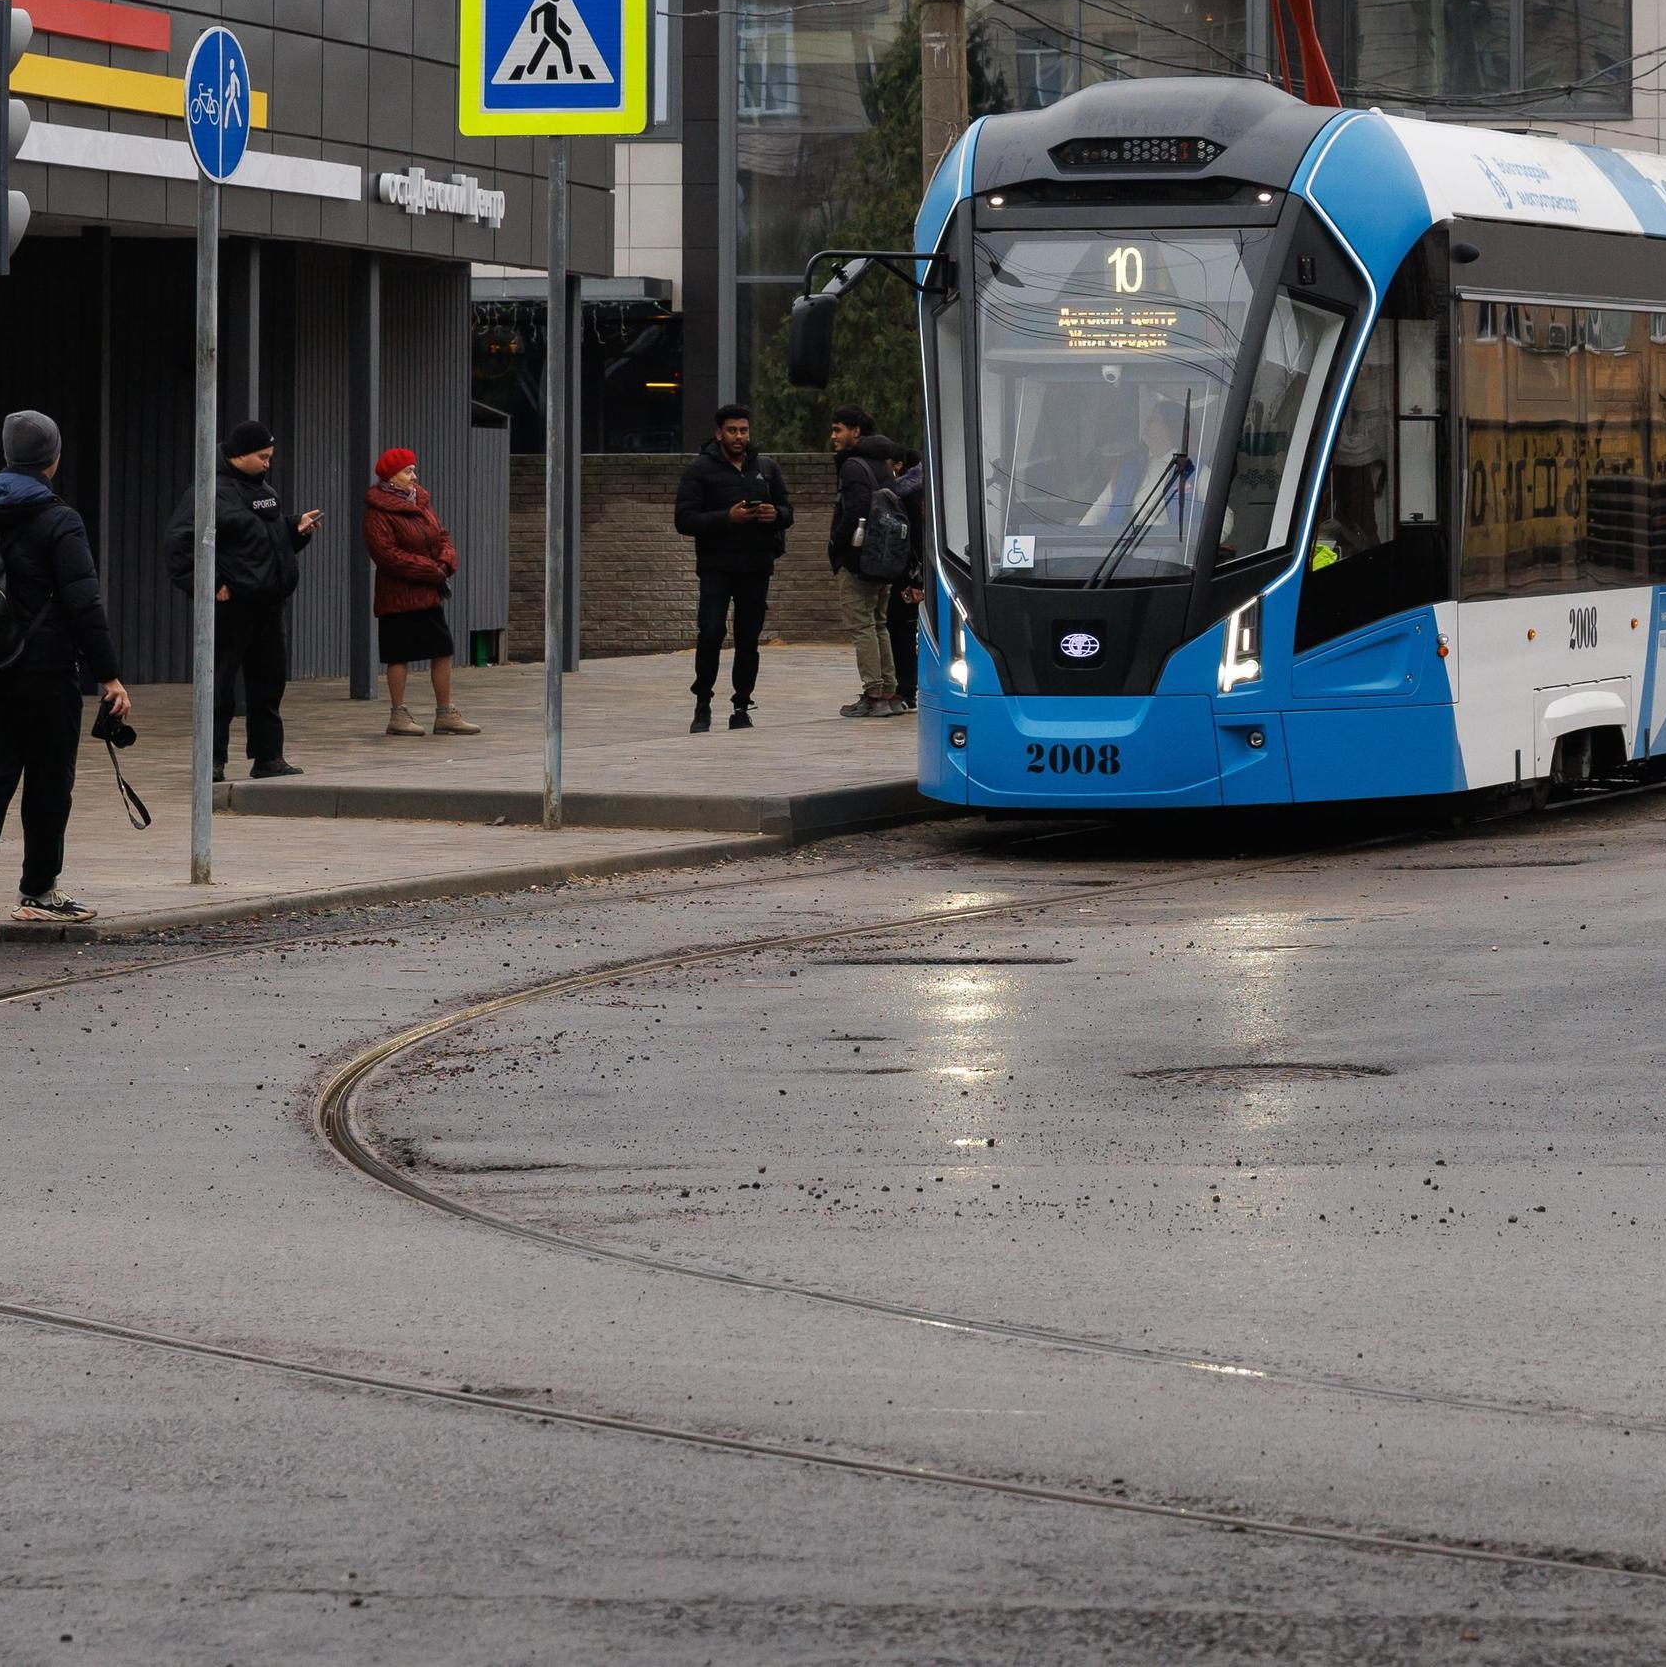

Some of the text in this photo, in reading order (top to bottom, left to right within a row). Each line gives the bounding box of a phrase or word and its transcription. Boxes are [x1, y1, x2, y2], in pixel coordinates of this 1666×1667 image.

[1107, 246, 1144, 293] 10
[252, 497, 278, 510] SPORTS
[1569, 606, 1598, 651] 2008
[1026, 743, 1121, 776] 2008
